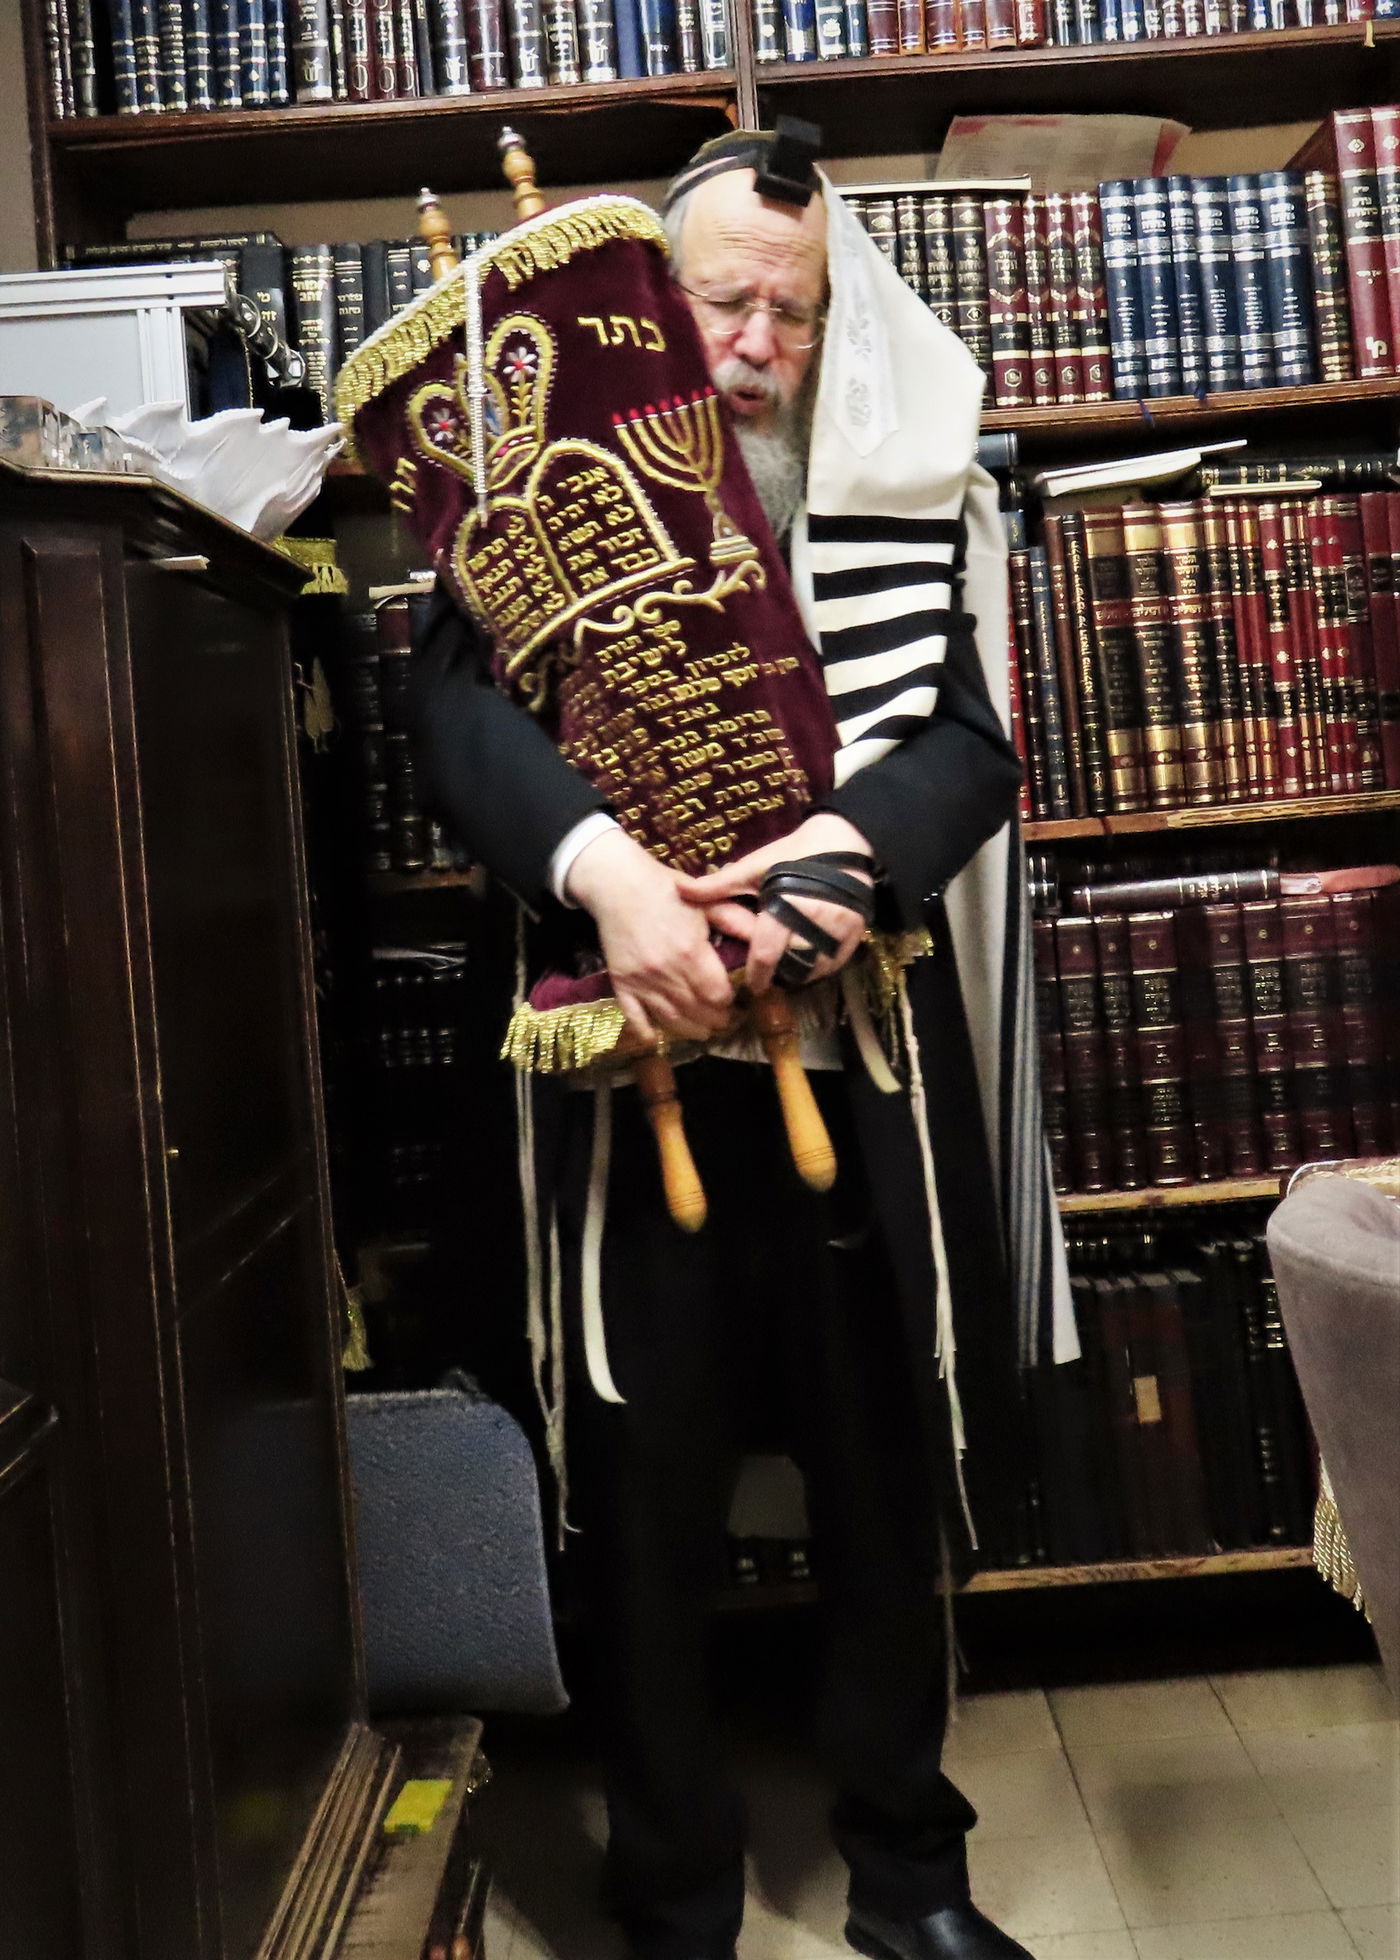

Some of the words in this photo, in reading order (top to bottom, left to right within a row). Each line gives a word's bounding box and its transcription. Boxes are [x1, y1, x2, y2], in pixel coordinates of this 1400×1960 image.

[576, 312, 668, 354] כתר
[557, 466, 610, 493] אנכי
[592, 483, 623, 504] לא
[546, 499, 589, 530] יהיה
[606, 504, 635, 526] לא
[559, 521, 603, 551] תשא
[597, 529, 645, 552] זכור
[568, 549, 597, 570] את
[611, 547, 658, 571] כבד
[579, 568, 610, 590] את
[1069, 573, 1085, 614] ירושלמי
[643, 619, 680, 637] ספר
[1073, 614, 1087, 628] של
[596, 635, 643, 663] תורה
[1078, 628, 1092, 655] הגאון
[601, 637, 686, 688] לישיבת
[721, 664, 759, 686] יוסף
[1078, 656, 1093, 694] מווילנא
[670, 742, 725, 771] משה
[714, 781, 759, 803] מרת
[725, 795, 784, 822] אברהם
